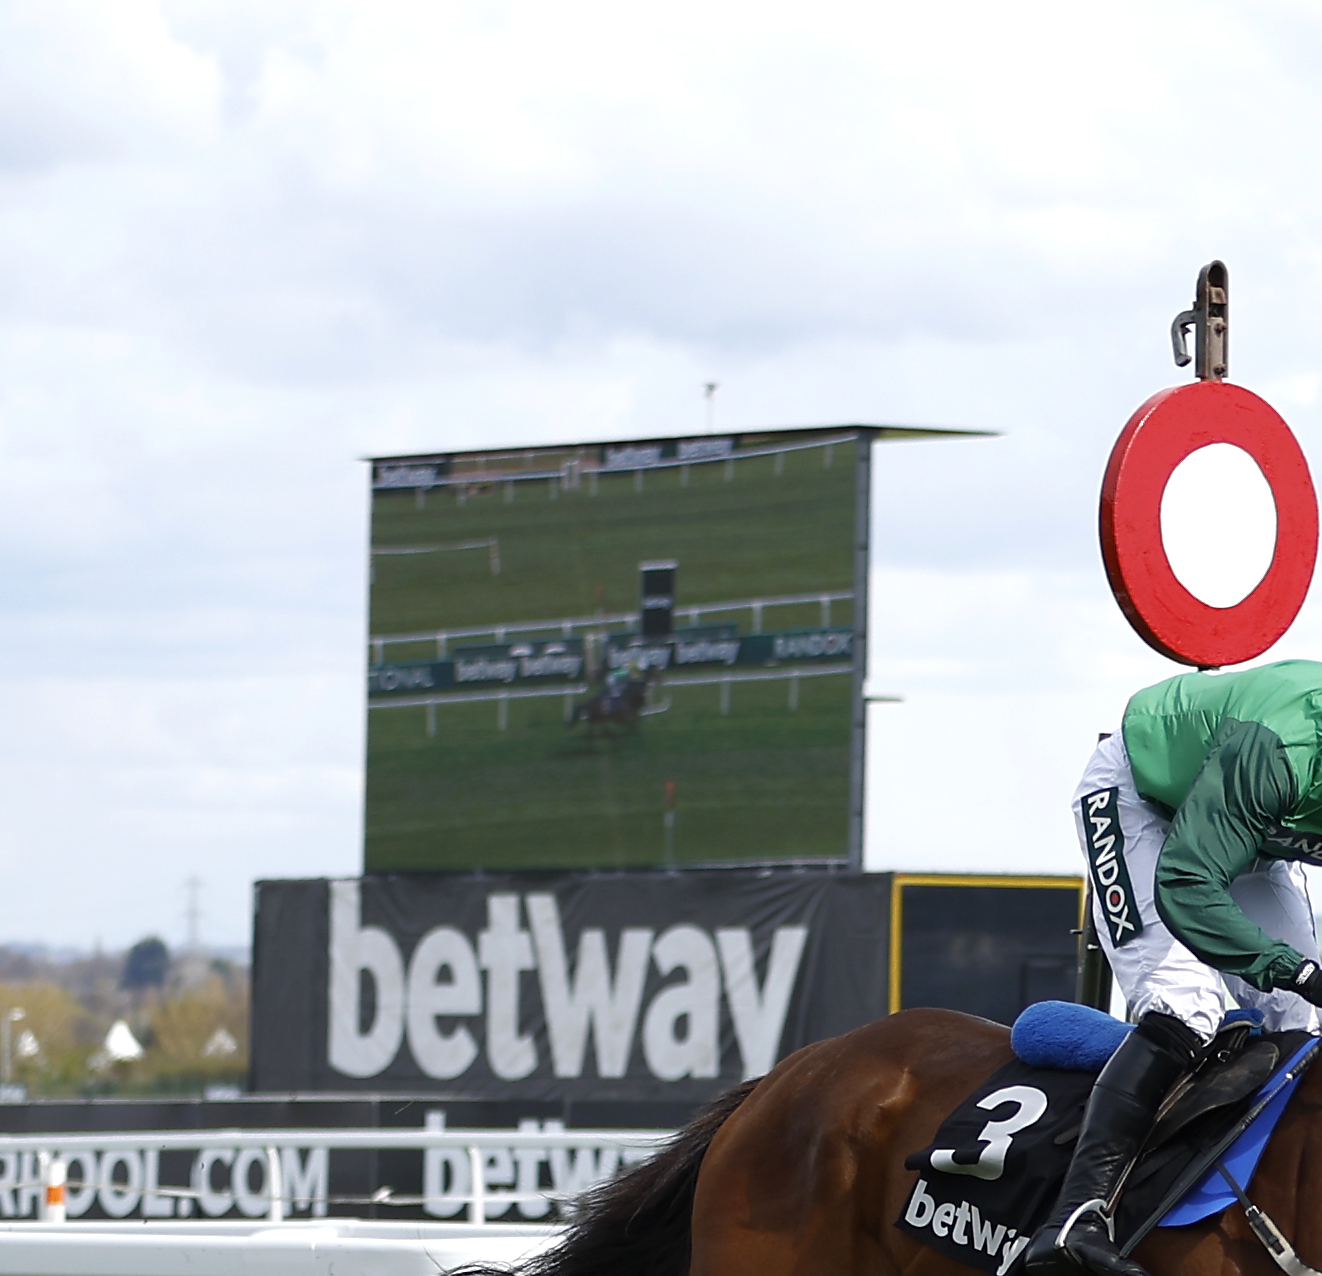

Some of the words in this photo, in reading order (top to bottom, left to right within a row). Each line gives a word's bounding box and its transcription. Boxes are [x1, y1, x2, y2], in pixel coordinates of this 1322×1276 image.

[1087, 790, 1136, 942] RANDOX
[327, 881, 808, 1082] betway
[930, 1085, 1048, 1181] 3
